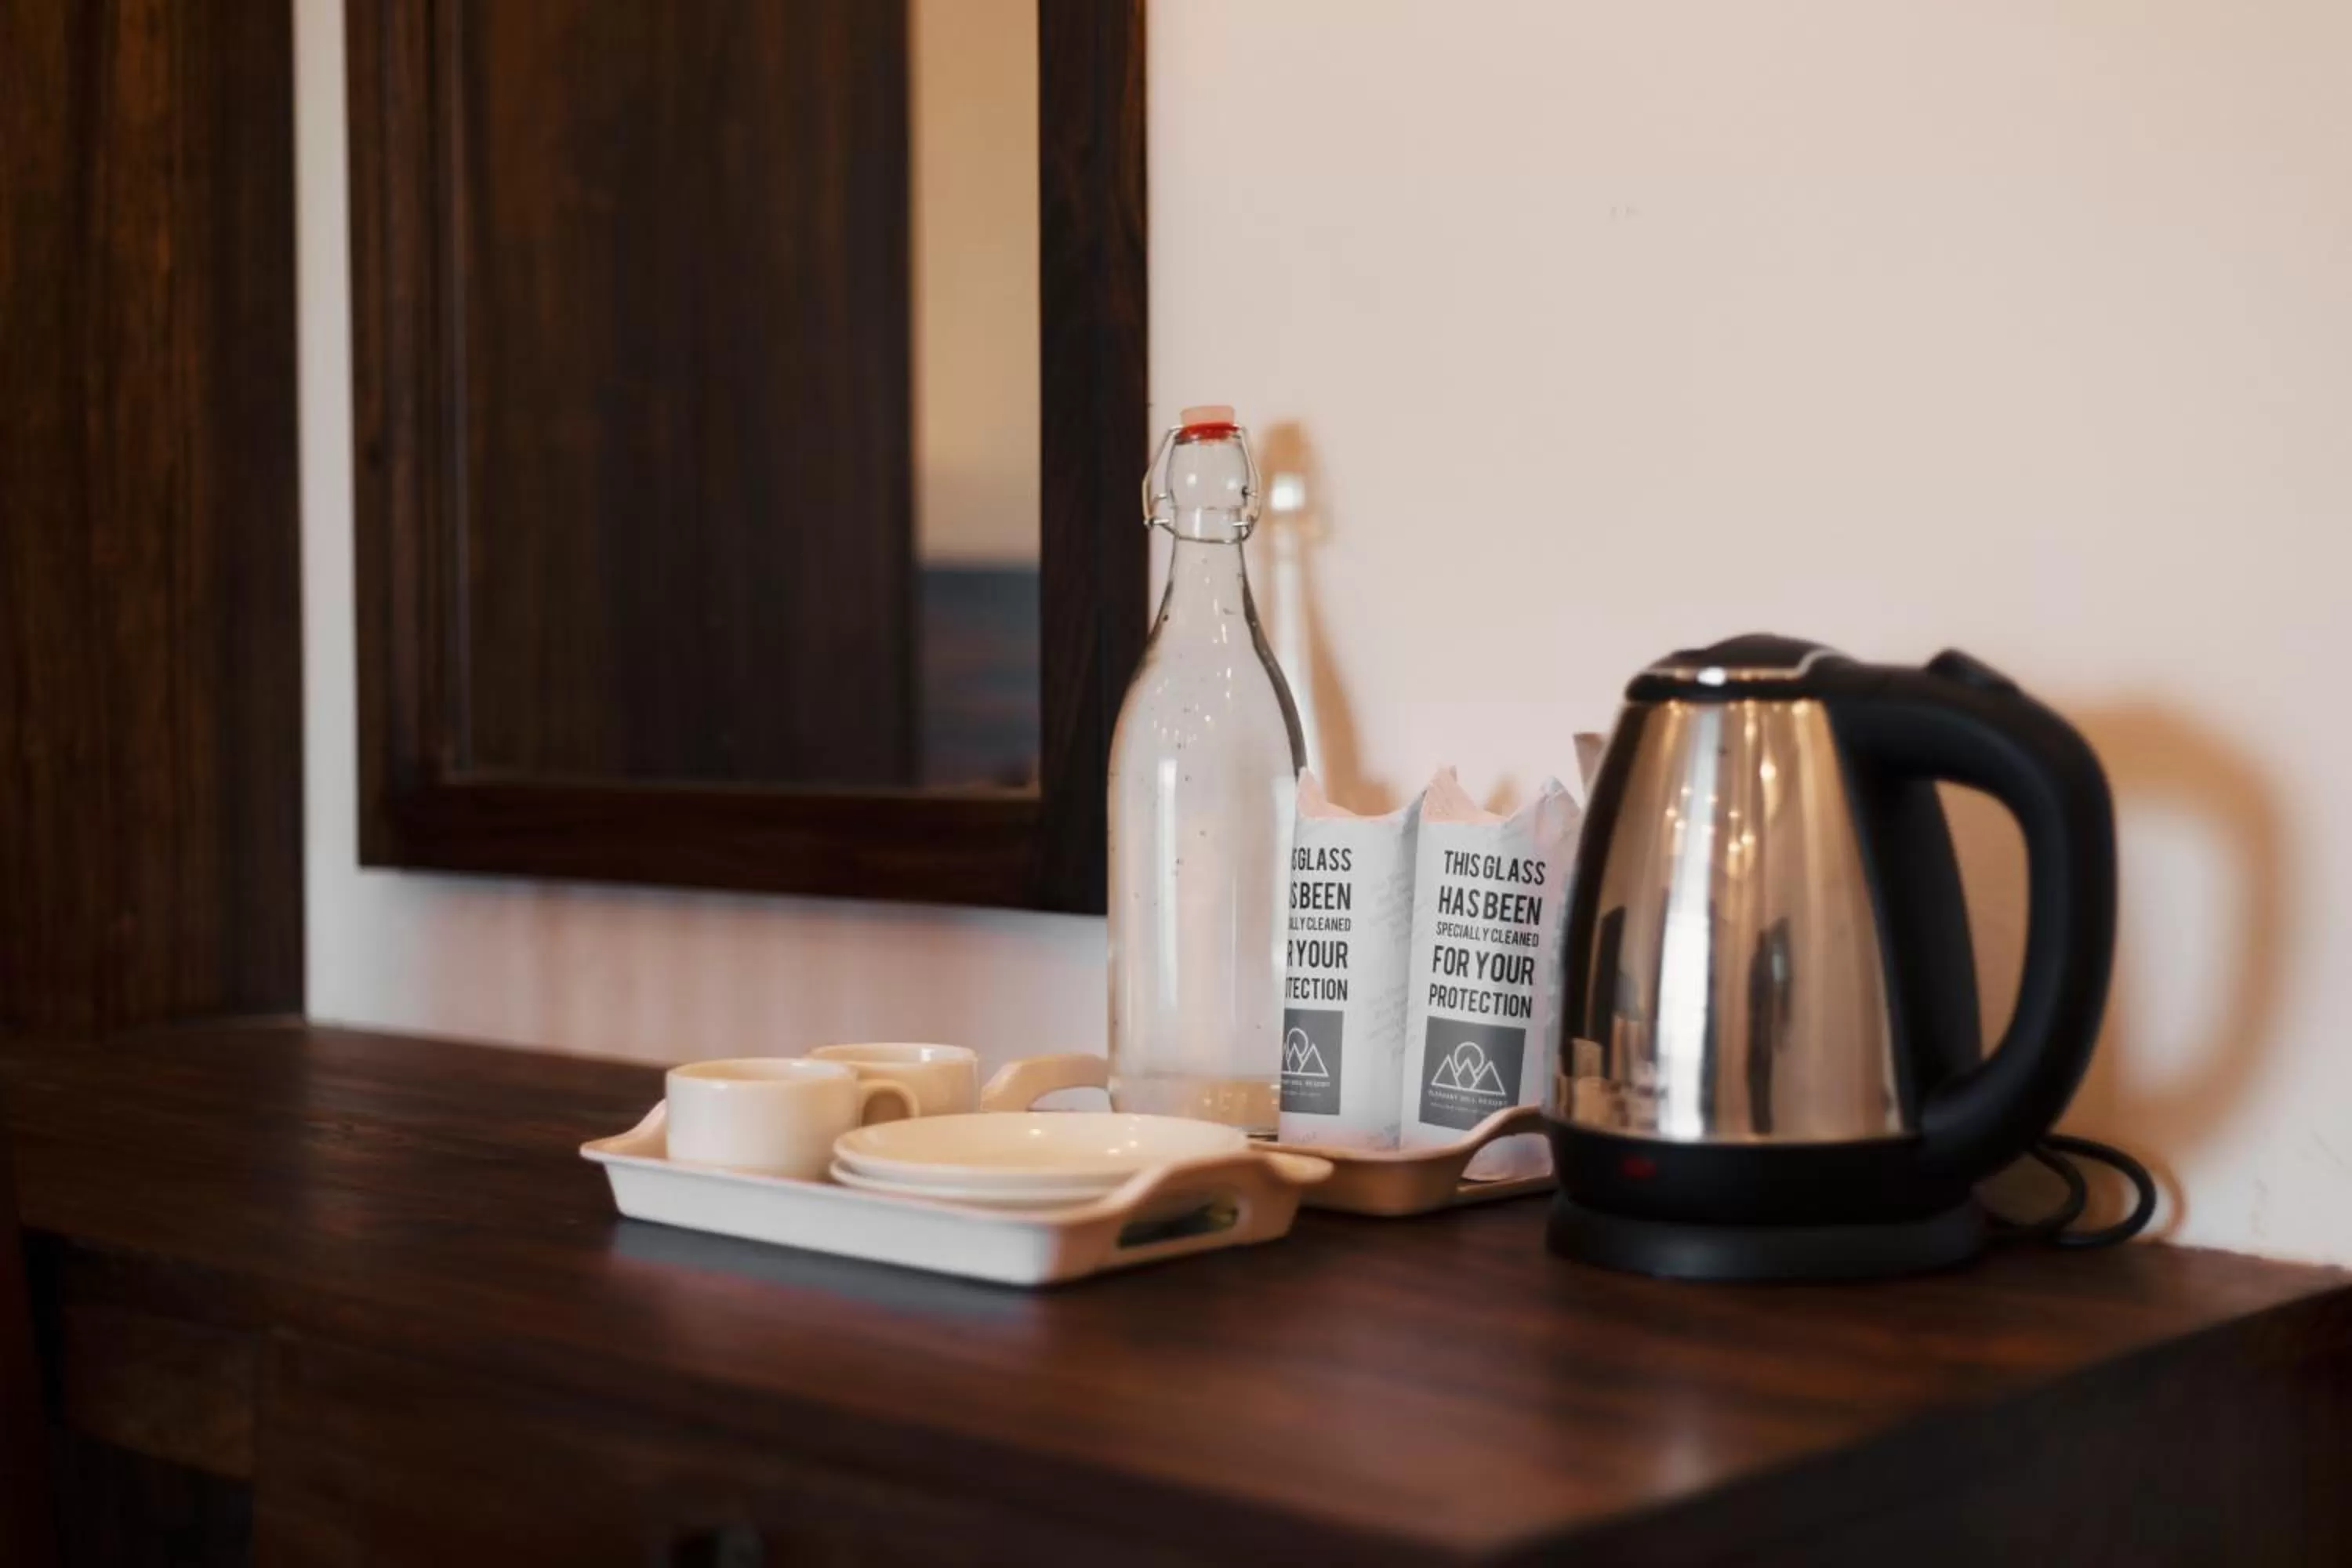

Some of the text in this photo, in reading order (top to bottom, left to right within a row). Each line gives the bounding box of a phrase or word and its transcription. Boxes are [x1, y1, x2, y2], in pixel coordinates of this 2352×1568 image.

[1298, 848, 1352, 871] GLASS
[1444, 850, 1547, 885] THIS GLASS
[1299, 882, 1351, 910] BEEN
[1438, 885, 1541, 925] HAS BEEN
[1306, 916, 1352, 931] CLEANED
[1436, 921, 1539, 948] SPECIALLY CLEANED
[1296, 939, 1348, 969] YOUR
[1432, 944, 1535, 986] FOR YOUR
[1286, 976, 1348, 1001] TECTION
[1428, 982, 1533, 1018] PROTECTION
